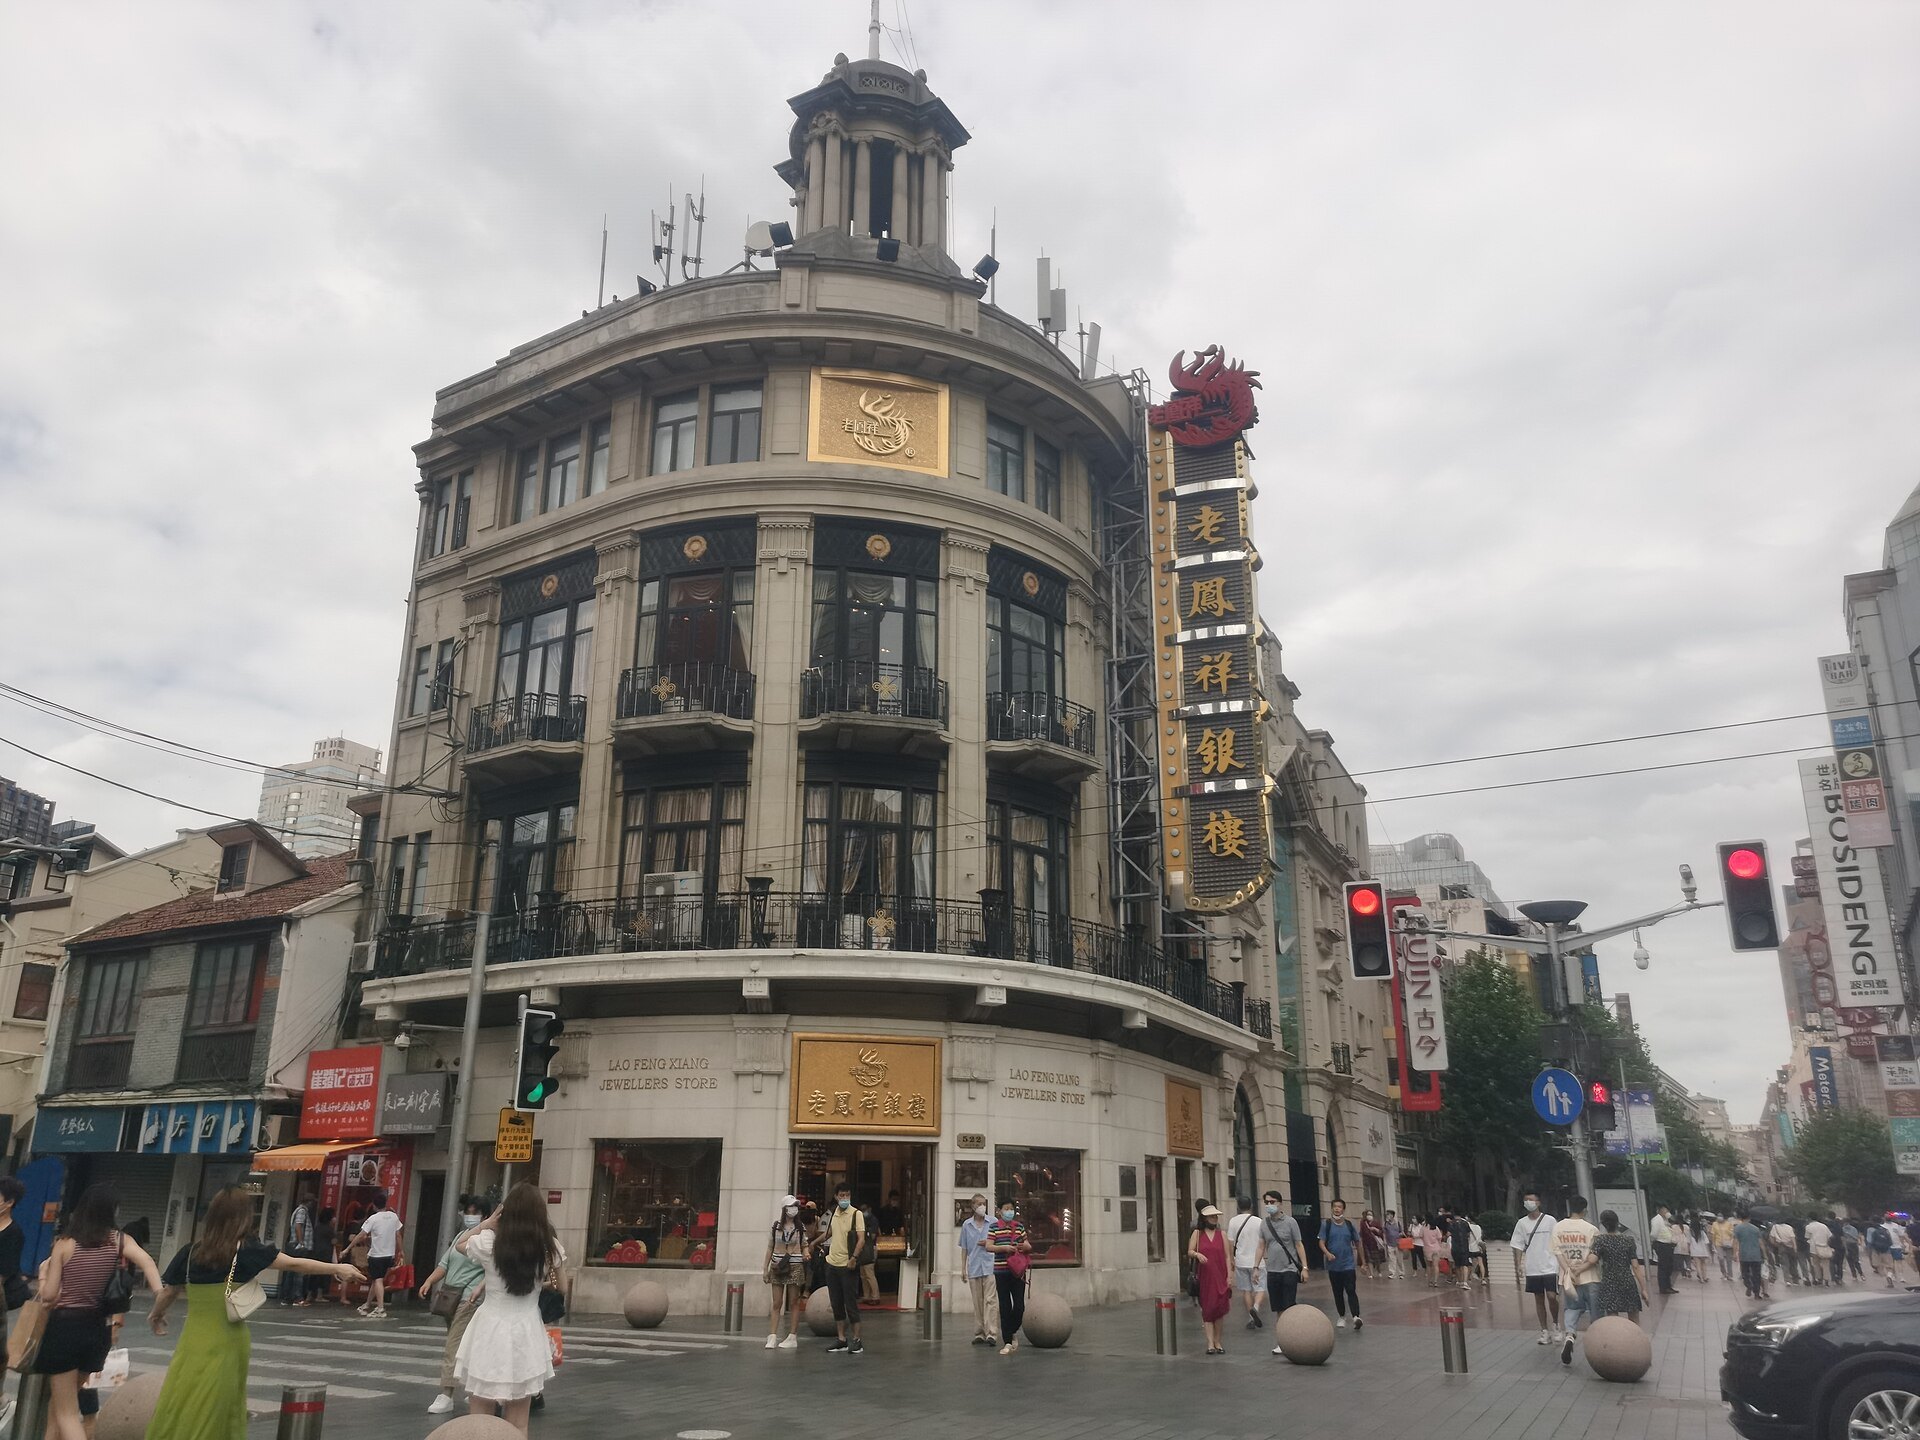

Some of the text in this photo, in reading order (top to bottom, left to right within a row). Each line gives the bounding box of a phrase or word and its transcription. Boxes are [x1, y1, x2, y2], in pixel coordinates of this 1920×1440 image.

[1187, 504, 1249, 860] 老鳳祥銀樓
[1849, 978, 1888, 990] 波司登
[1411, 1007, 1441, 1058] 古今
[608, 1057, 710, 1071] LAO FENG XIANG
[599, 1077, 718, 1091] JEWELLERS STORE
[1009, 1068, 1080, 1086] LAO FENG XIANG
[1001, 1087, 1086, 1105] JEWELLERS STORE
[807, 1089, 927, 1120] 老鳳祥銀樓
[962, 1135, 982, 1143] 522
[1557, 1234, 1587, 1243] YHWH
[1564, 1249, 1583, 1260] 123
